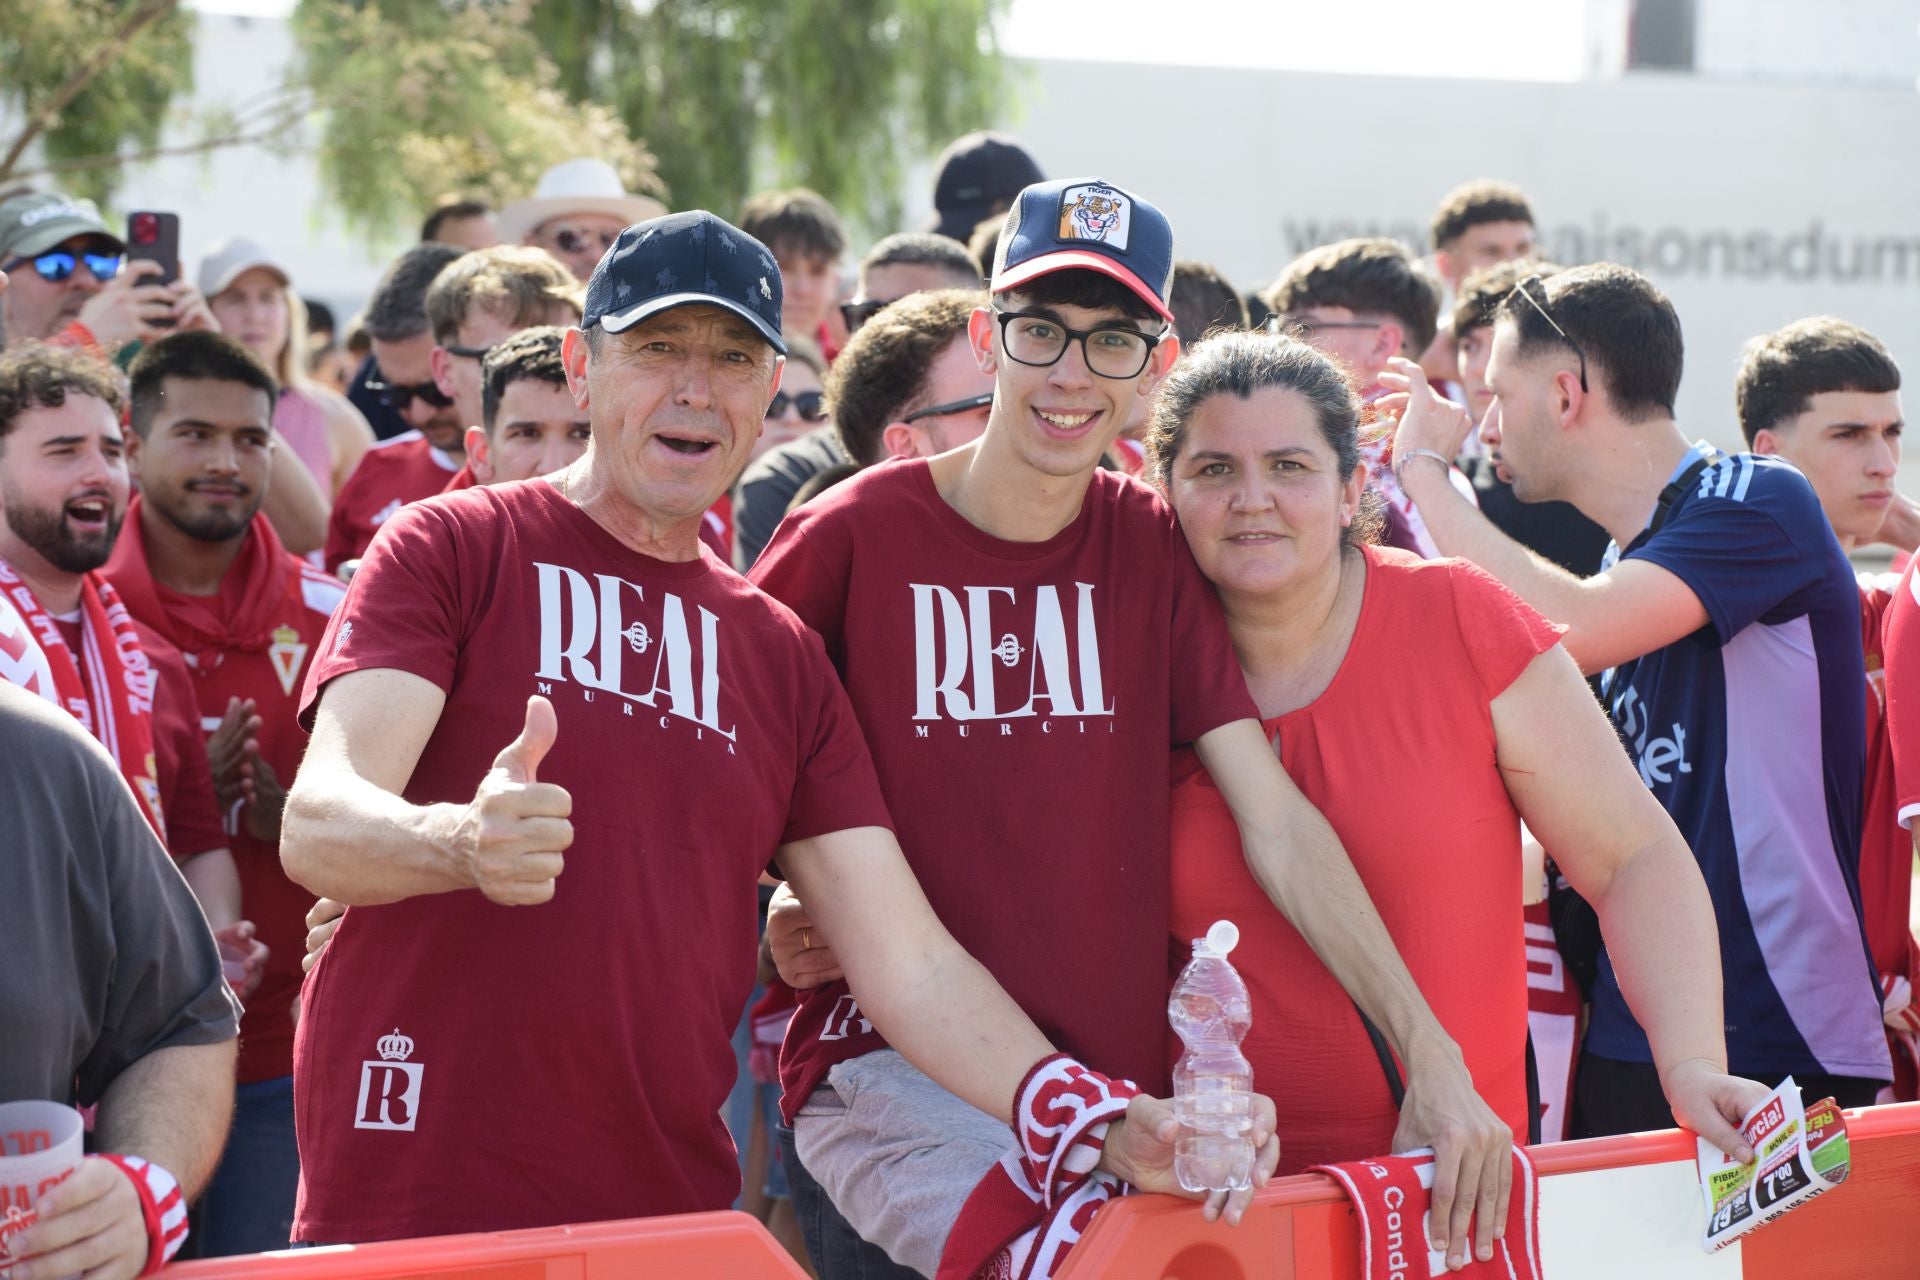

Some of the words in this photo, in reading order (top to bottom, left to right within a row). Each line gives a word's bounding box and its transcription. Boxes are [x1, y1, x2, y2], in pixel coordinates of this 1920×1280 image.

[1087, 187, 1112, 196] TIGER
[532, 561, 737, 743] REAL
[908, 581, 1115, 721] REAL
[537, 681, 736, 756] MURCIA
[915, 720, 1113, 738] MURCI
[359, 1065, 412, 1126] R
[1746, 1103, 1784, 1145] urcia!
